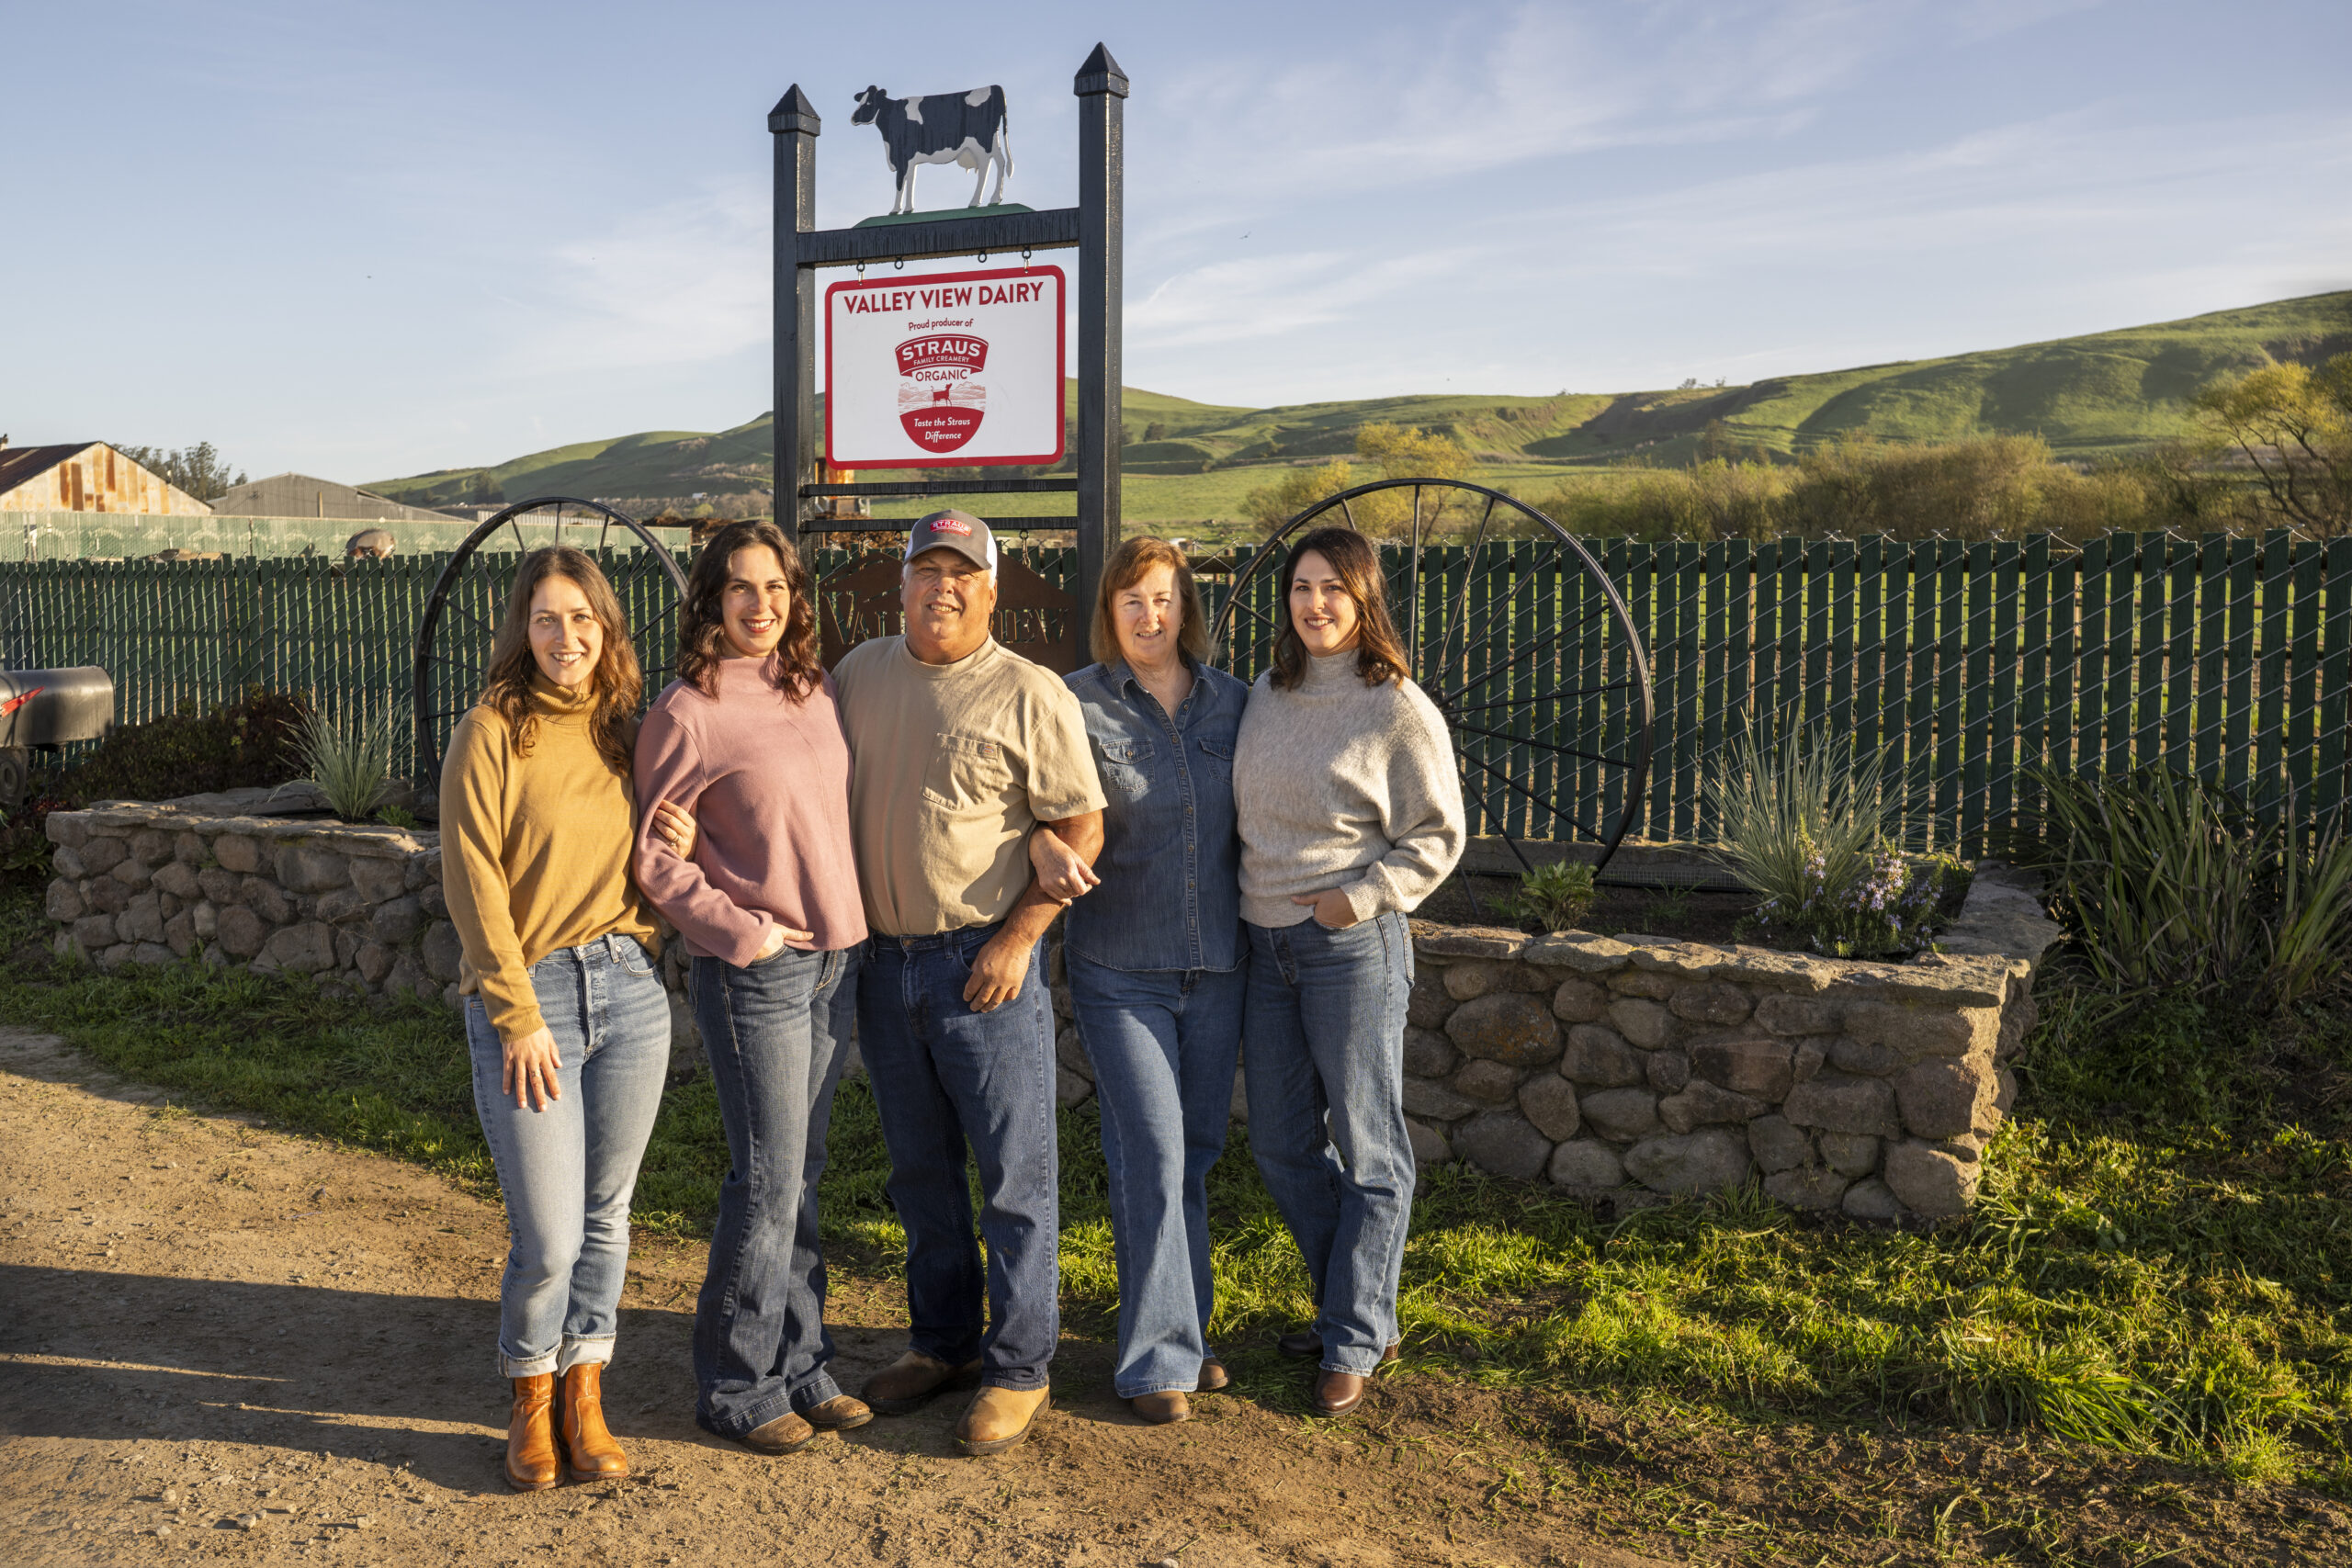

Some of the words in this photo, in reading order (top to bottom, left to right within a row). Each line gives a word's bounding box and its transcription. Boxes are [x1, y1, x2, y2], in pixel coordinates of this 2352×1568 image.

[844, 290, 916, 314] VALLEY
[920, 287, 972, 309] VIEW
[978, 281, 1044, 306] DAIRY
[908, 319, 930, 331] Proud
[931, 318, 964, 331] producer
[965, 318, 974, 327] of
[902, 340, 981, 361] STRAUS
[913, 356, 935, 366] FAMILY
[915, 369, 967, 382] ORGANIC
[914, 418, 933, 427] Taste
[933, 418, 945, 426] the
[947, 416, 970, 426] Straus
[924, 431, 962, 443] Difference
